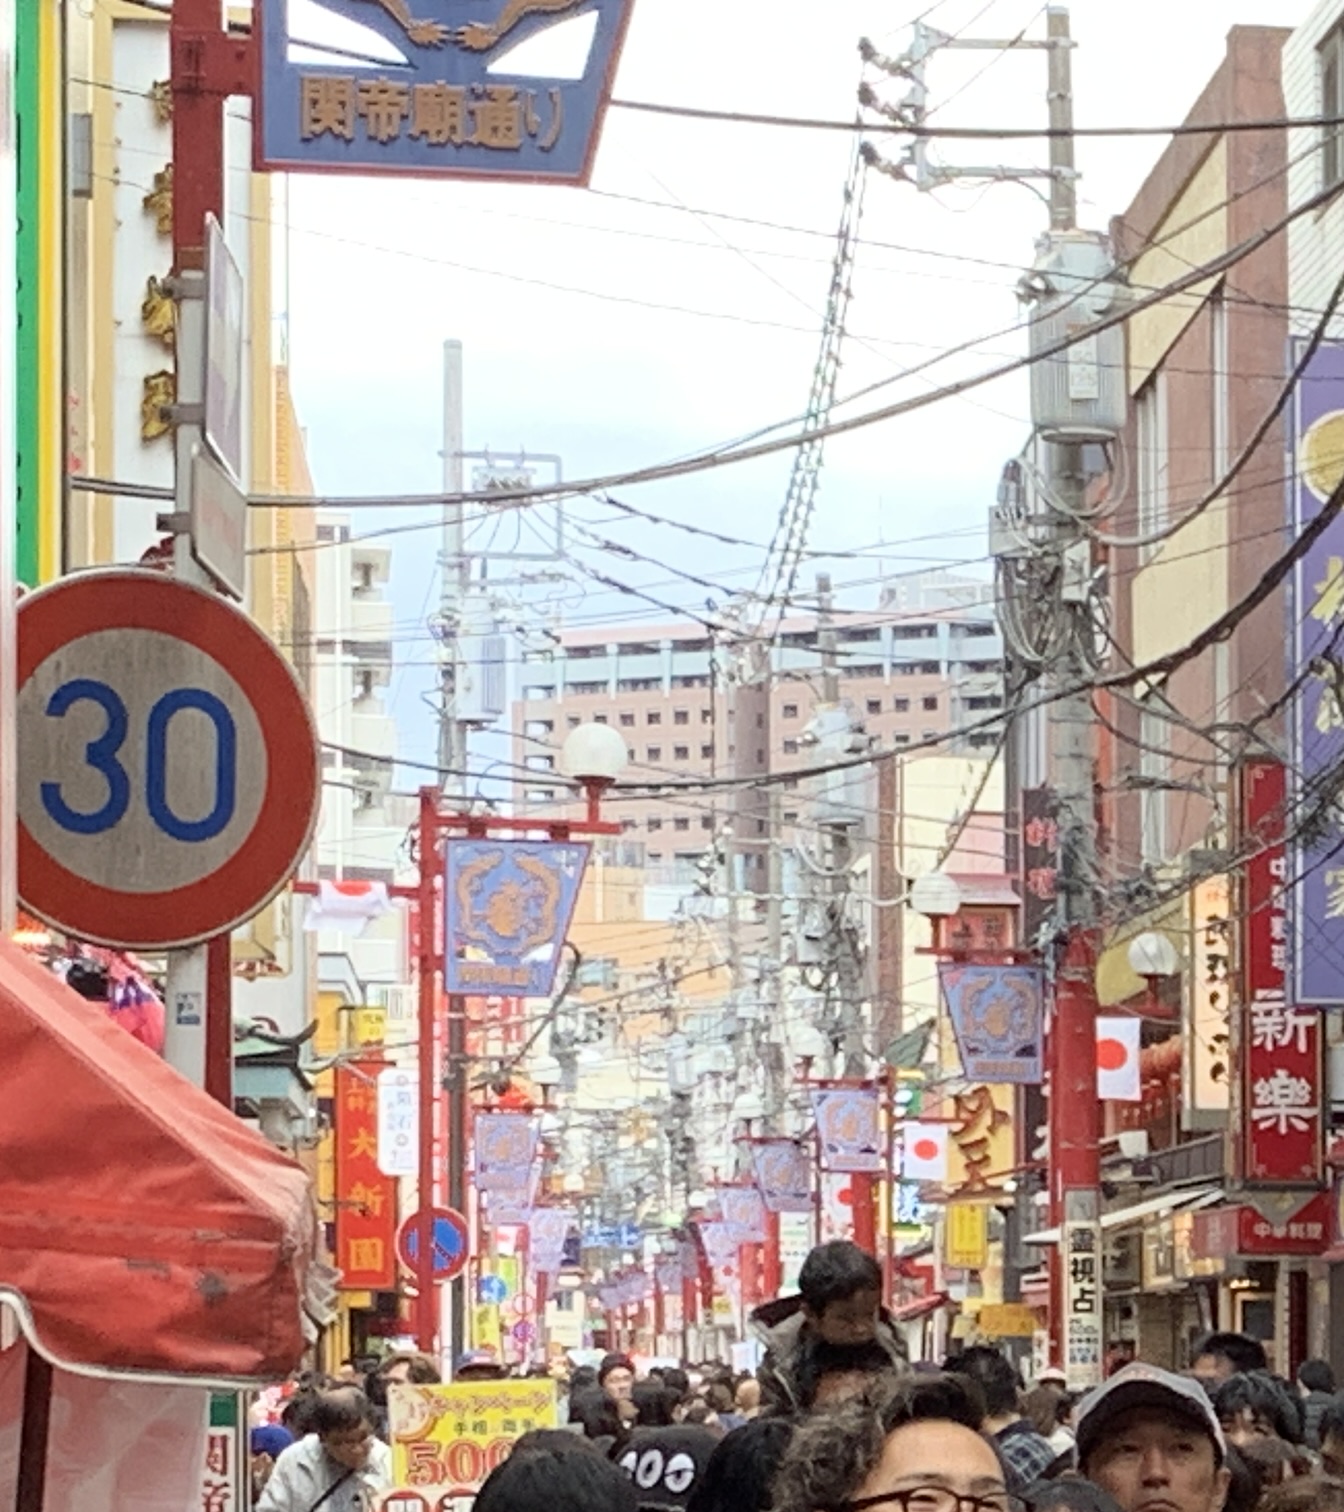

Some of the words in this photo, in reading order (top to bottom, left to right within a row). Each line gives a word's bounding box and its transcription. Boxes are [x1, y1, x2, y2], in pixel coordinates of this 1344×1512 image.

[301, 75, 565, 151] 関帝廟通り
[41, 678, 236, 844] 30
